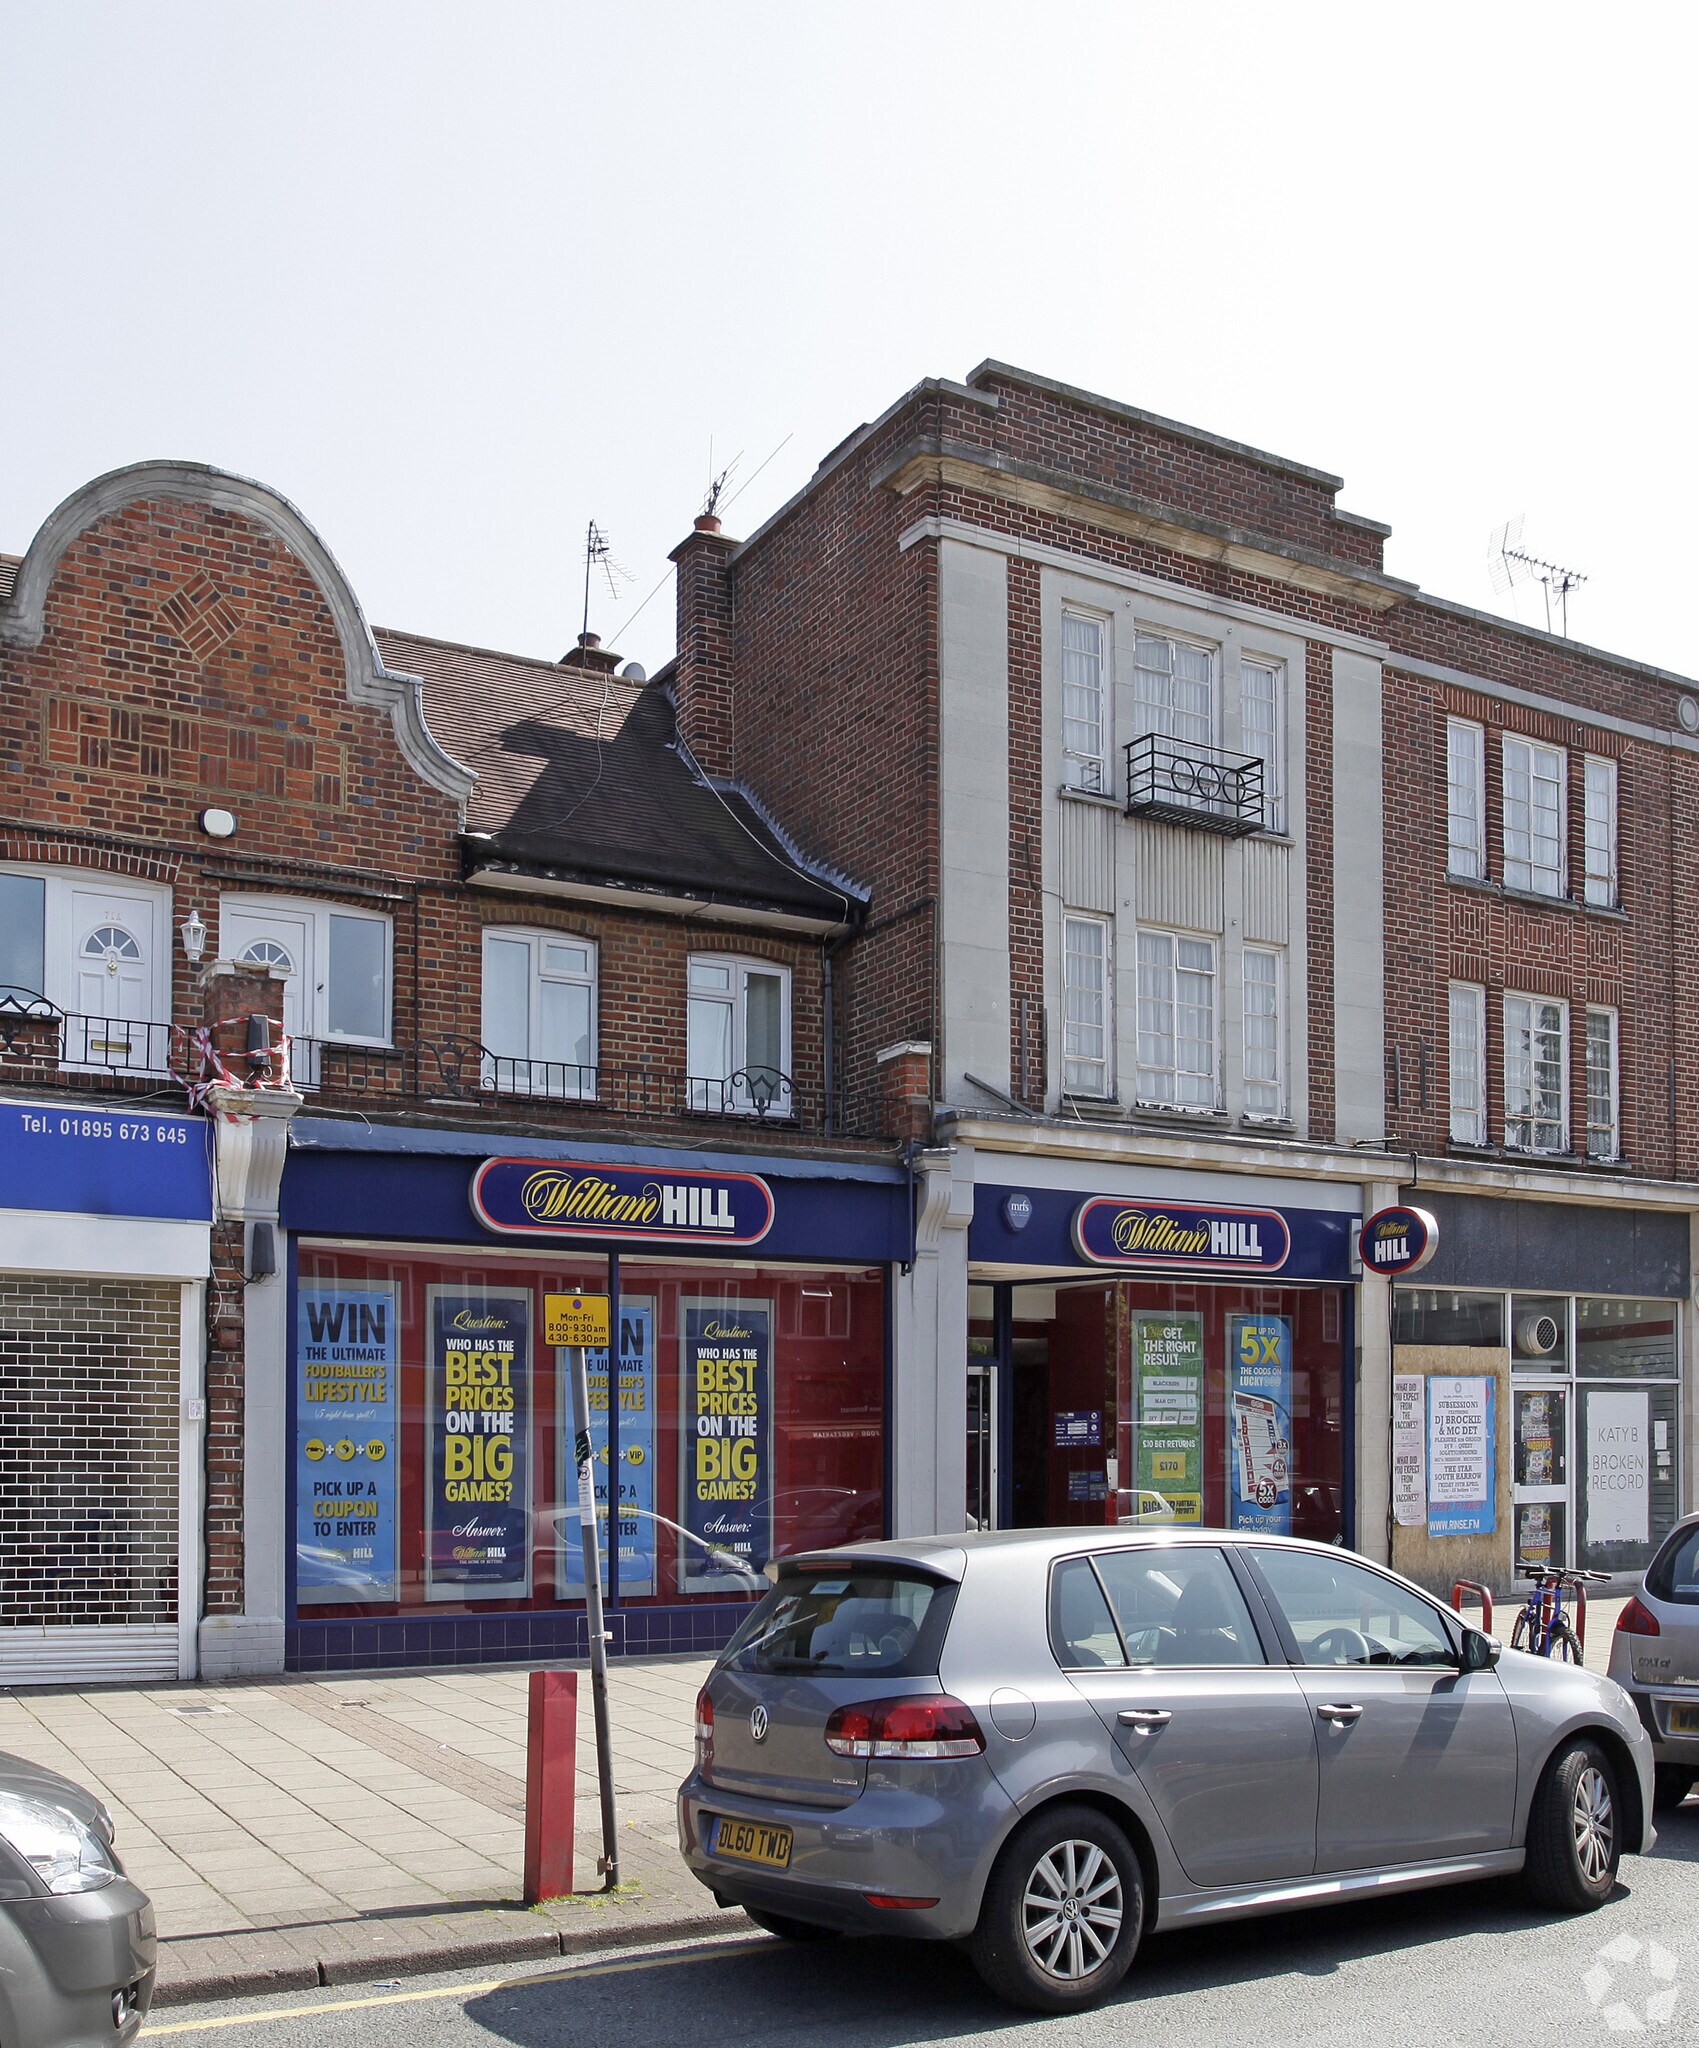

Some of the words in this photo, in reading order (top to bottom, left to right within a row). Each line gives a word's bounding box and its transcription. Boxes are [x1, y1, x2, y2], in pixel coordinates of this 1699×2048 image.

[21, 1114, 52, 1133] Tel.
[60, 1118, 112, 1138] 01895
[119, 1123, 150, 1142] 673
[156, 1126, 187, 1144] 645
[521, 1169, 663, 1223] William
[663, 1185, 735, 1228] HILL
[1011, 1200, 1029, 1212] mrfs
[1111, 1209, 1210, 1254] William
[1211, 1221, 1262, 1257] HILL
[1375, 1237, 1410, 1263] HILL
[306, 1302, 386, 1344] WIN
[451, 1309, 508, 1331] Question:
[703, 1320, 752, 1340] Question:
[1163, 1328, 1182, 1339] GET
[446, 1339, 471, 1350] WHO
[475, 1339, 495, 1351] HAS
[498, 1340, 514, 1351] THE
[1144, 1340, 1164, 1352] THE
[1166, 1341, 1196, 1353] RIGHT
[306, 1347, 327, 1360] THE
[332, 1348, 386, 1360] ULTIMATE
[697, 1348, 720, 1359] WHO
[722, 1348, 740, 1359] HAS
[743, 1349, 757, 1359] THE
[1144, 1353, 1180, 1366] RESULT.
[305, 1364, 386, 1378] FOOTBALLER'S
[446, 1351, 514, 1386] BEST
[697, 1360, 757, 1391] BEST
[1240, 1367, 1252, 1375] THE
[1253, 1367, 1271, 1375] ODDS
[1240, 1377, 1263, 1386] LUCKY
[305, 1381, 387, 1403] LIFESTYLE
[446, 1386, 514, 1410] PRICES
[697, 1393, 758, 1415] PRICES
[1438, 1401, 1478, 1409] SUBSESSIONS
[446, 1411, 474, 1433] ON
[481, 1412, 514, 1433] THE
[697, 1416, 722, 1436] ON
[728, 1416, 757, 1436] THE
[1435, 1416, 1444, 1426] DJ
[1446, 1416, 1481, 1424] BROCKIE
[1439, 1427, 1445, 1435] &
[1447, 1426, 1460, 1435] MC
[1462, 1426, 1478, 1434] DET
[1599, 1426, 1629, 1442] KATY
[369, 1445, 383, 1454] VIP
[1167, 1440, 1196, 1448] RETURNS
[445, 1434, 514, 1480] BIG
[629, 1451, 642, 1459] VIP
[697, 1438, 757, 1480] BIG
[1593, 1455, 1644, 1470] BROKEN
[1160, 1461, 1178, 1471] £170
[314, 1482, 342, 1496] PICK
[347, 1482, 363, 1496] UP
[368, 1482, 377, 1496] A
[1593, 1474, 1644, 1490] RECORD
[445, 1481, 513, 1502] GAMES?
[629, 1485, 637, 1498] A
[697, 1481, 756, 1500] GAMES?
[314, 1500, 378, 1518] COUPON
[452, 1516, 507, 1537] Answer:
[703, 1514, 751, 1534] Answer:
[1238, 1515, 1254, 1524] Pick
[1255, 1516, 1264, 1525] up
[1265, 1515, 1281, 1525] your
[313, 1522, 331, 1536] TO
[337, 1521, 376, 1536] ENTER
[353, 1548, 374, 1558] HILL
[487, 1547, 507, 1558] HILL
[734, 1542, 752, 1552] HILL
[719, 1823, 755, 1851] DL60
[759, 1830, 788, 1860] TWD
